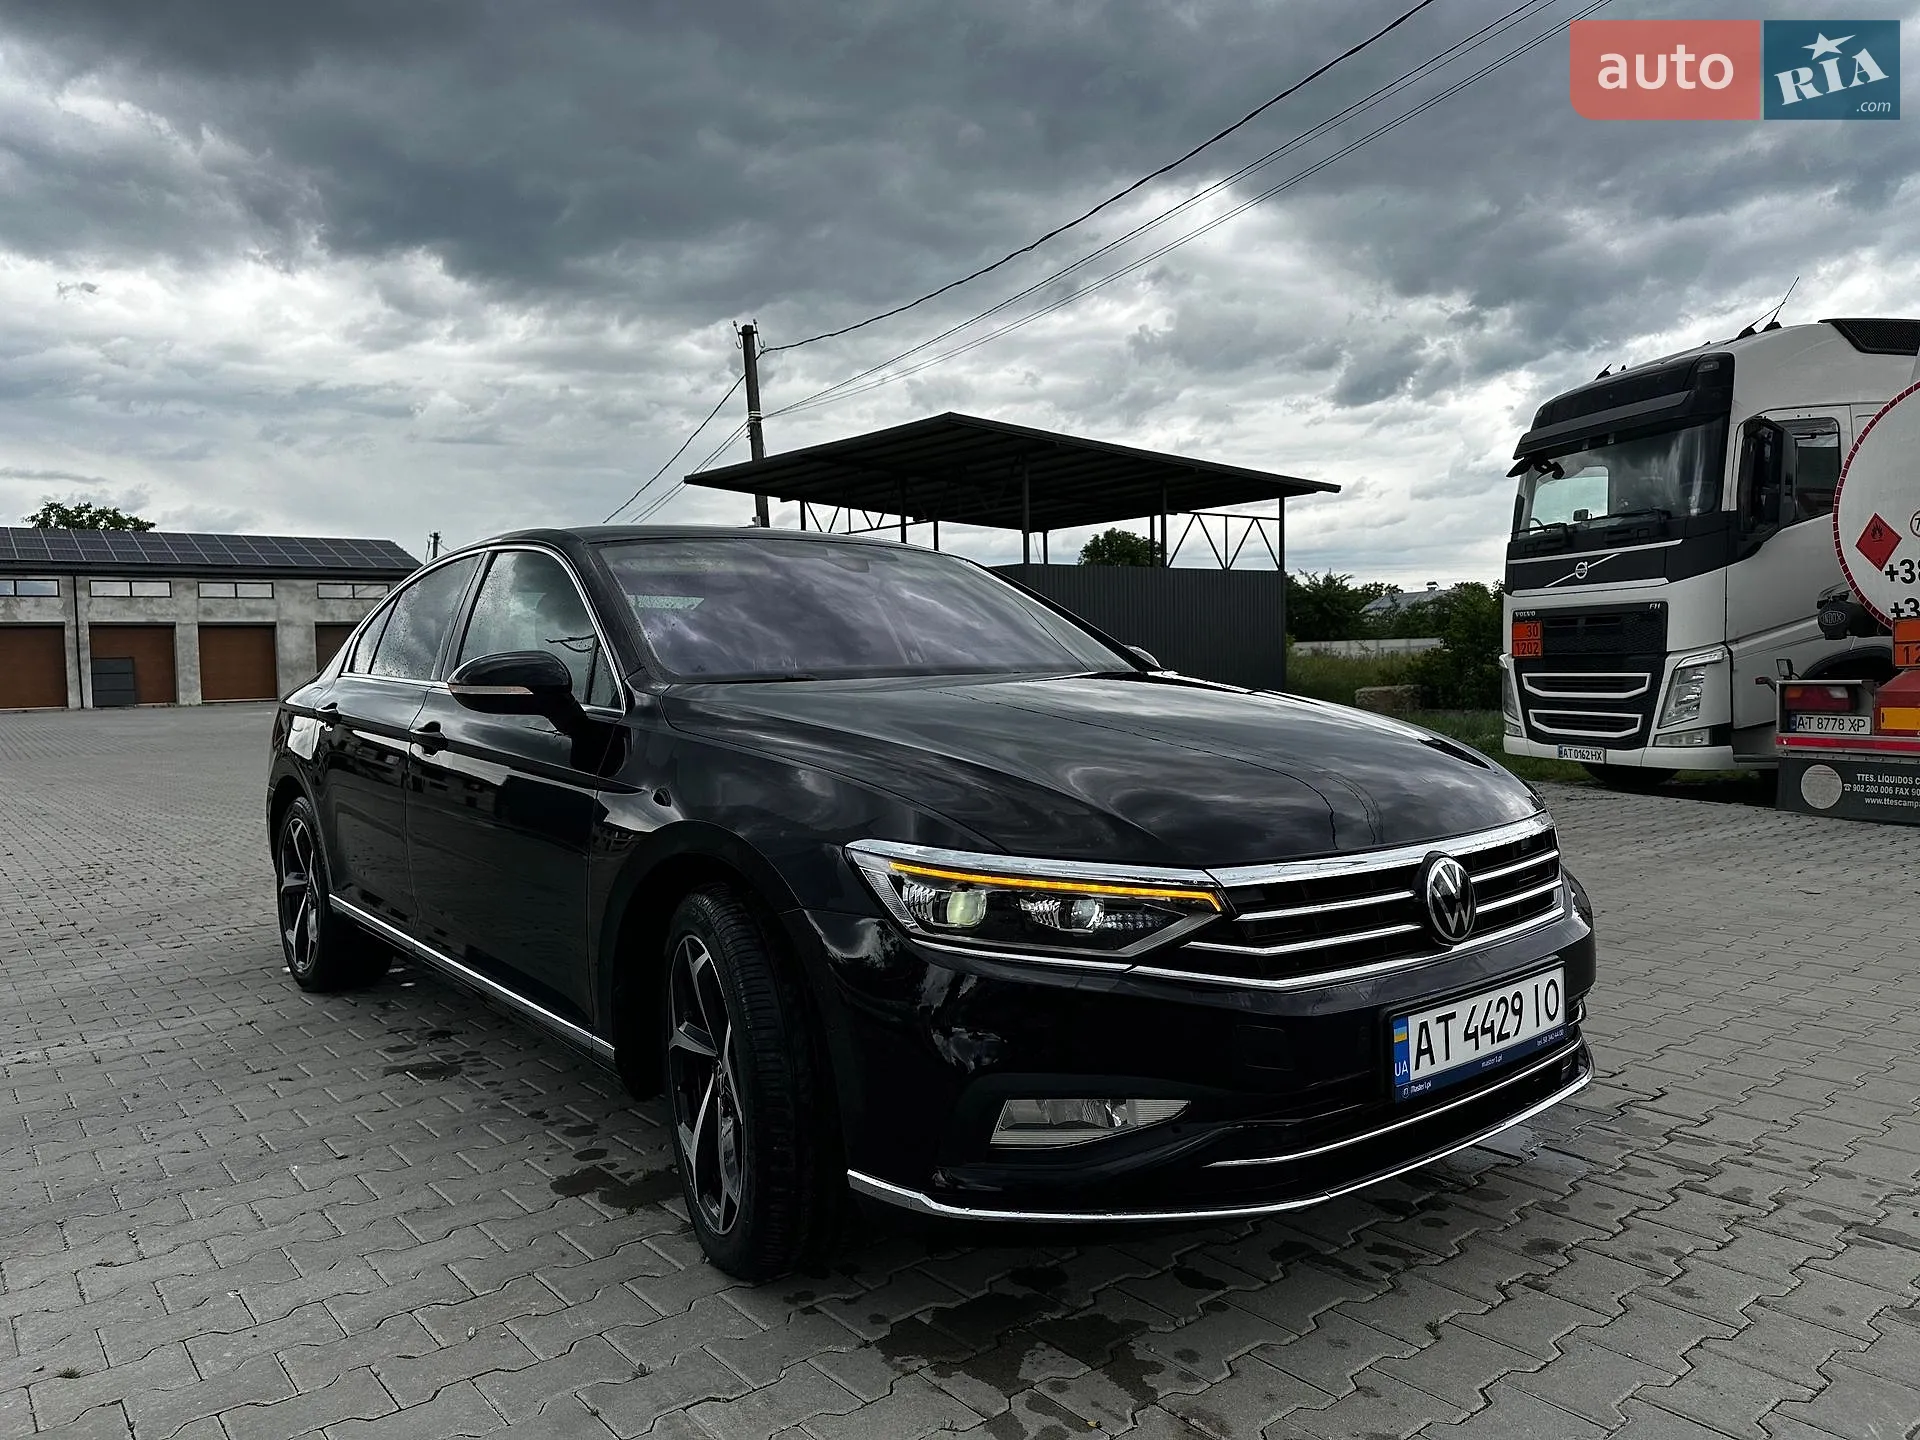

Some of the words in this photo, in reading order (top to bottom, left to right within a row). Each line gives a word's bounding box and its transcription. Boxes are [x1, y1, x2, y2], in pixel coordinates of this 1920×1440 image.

[1885, 559, 1920, 584] +3
[1527, 625, 1539, 637] 30
[1515, 641, 1539, 655] 1202
[1798, 716, 1814, 730] AT
[1817, 717, 1845, 731] 8778
[1848, 718, 1866, 732] XP
[1591, 750, 1603, 761] HX
[1852, 784, 1865, 793] 902
[1866, 784, 1879, 794] 200
[1880, 786, 1894, 794] 006
[1895, 786, 1910, 795] FAX
[1865, 797, 1920, 809] www.ttescamp
[1414, 1011, 1457, 1071] AT
[1463, 990, 1524, 1051] 4429
[1534, 978, 1560, 1028] IO
[1394, 1060, 1409, 1077] UA
